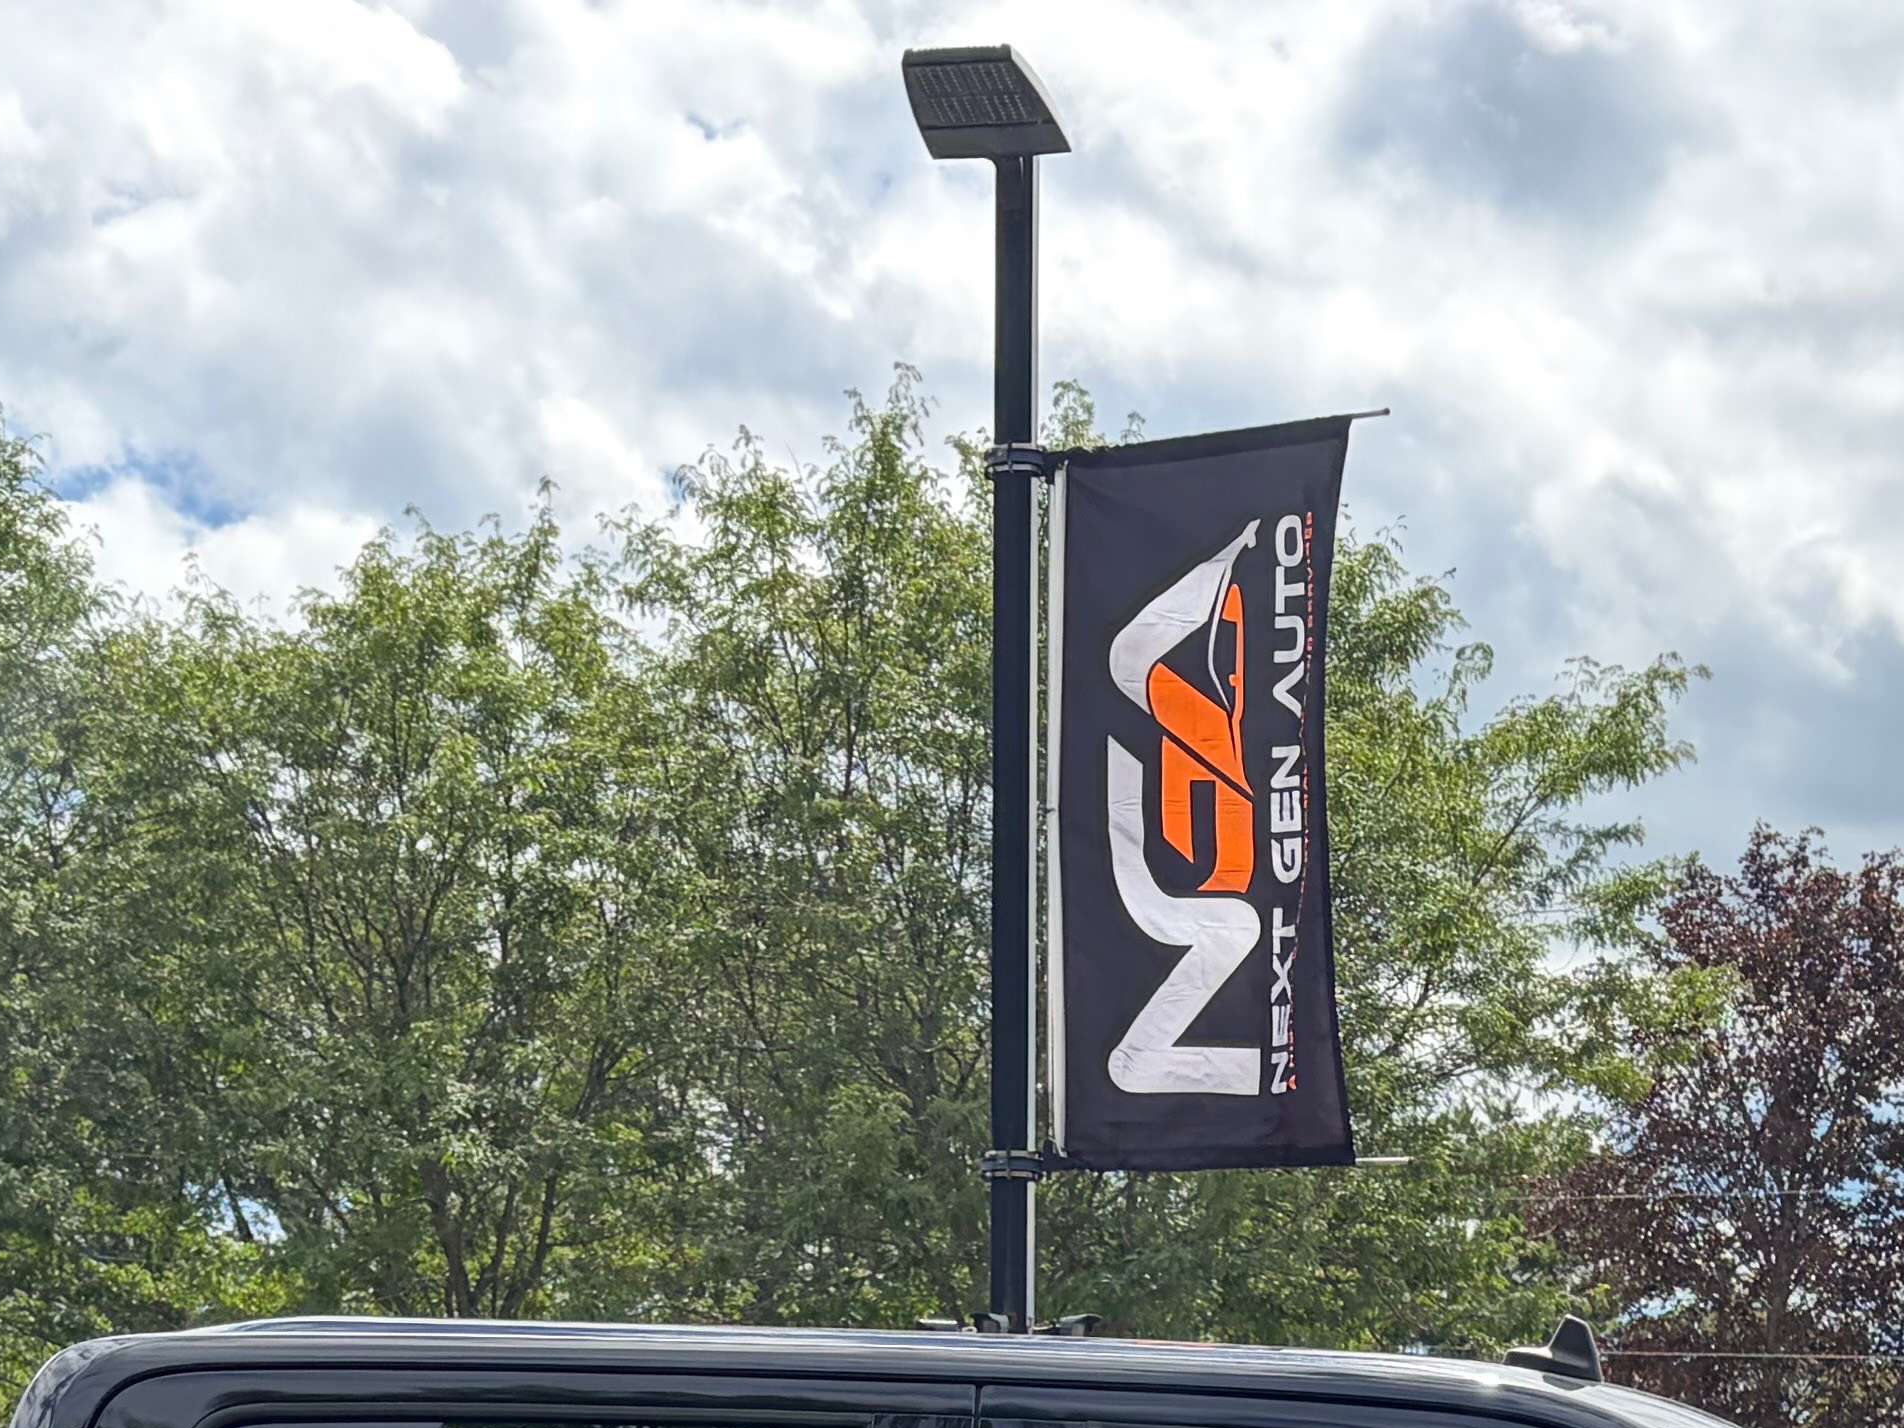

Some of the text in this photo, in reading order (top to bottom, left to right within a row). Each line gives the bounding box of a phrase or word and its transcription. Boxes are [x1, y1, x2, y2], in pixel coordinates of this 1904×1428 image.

[1272, 513, 1306, 717] AUTO
[1270, 745, 1303, 883] GEN
[1270, 908, 1298, 1095] NEXT
